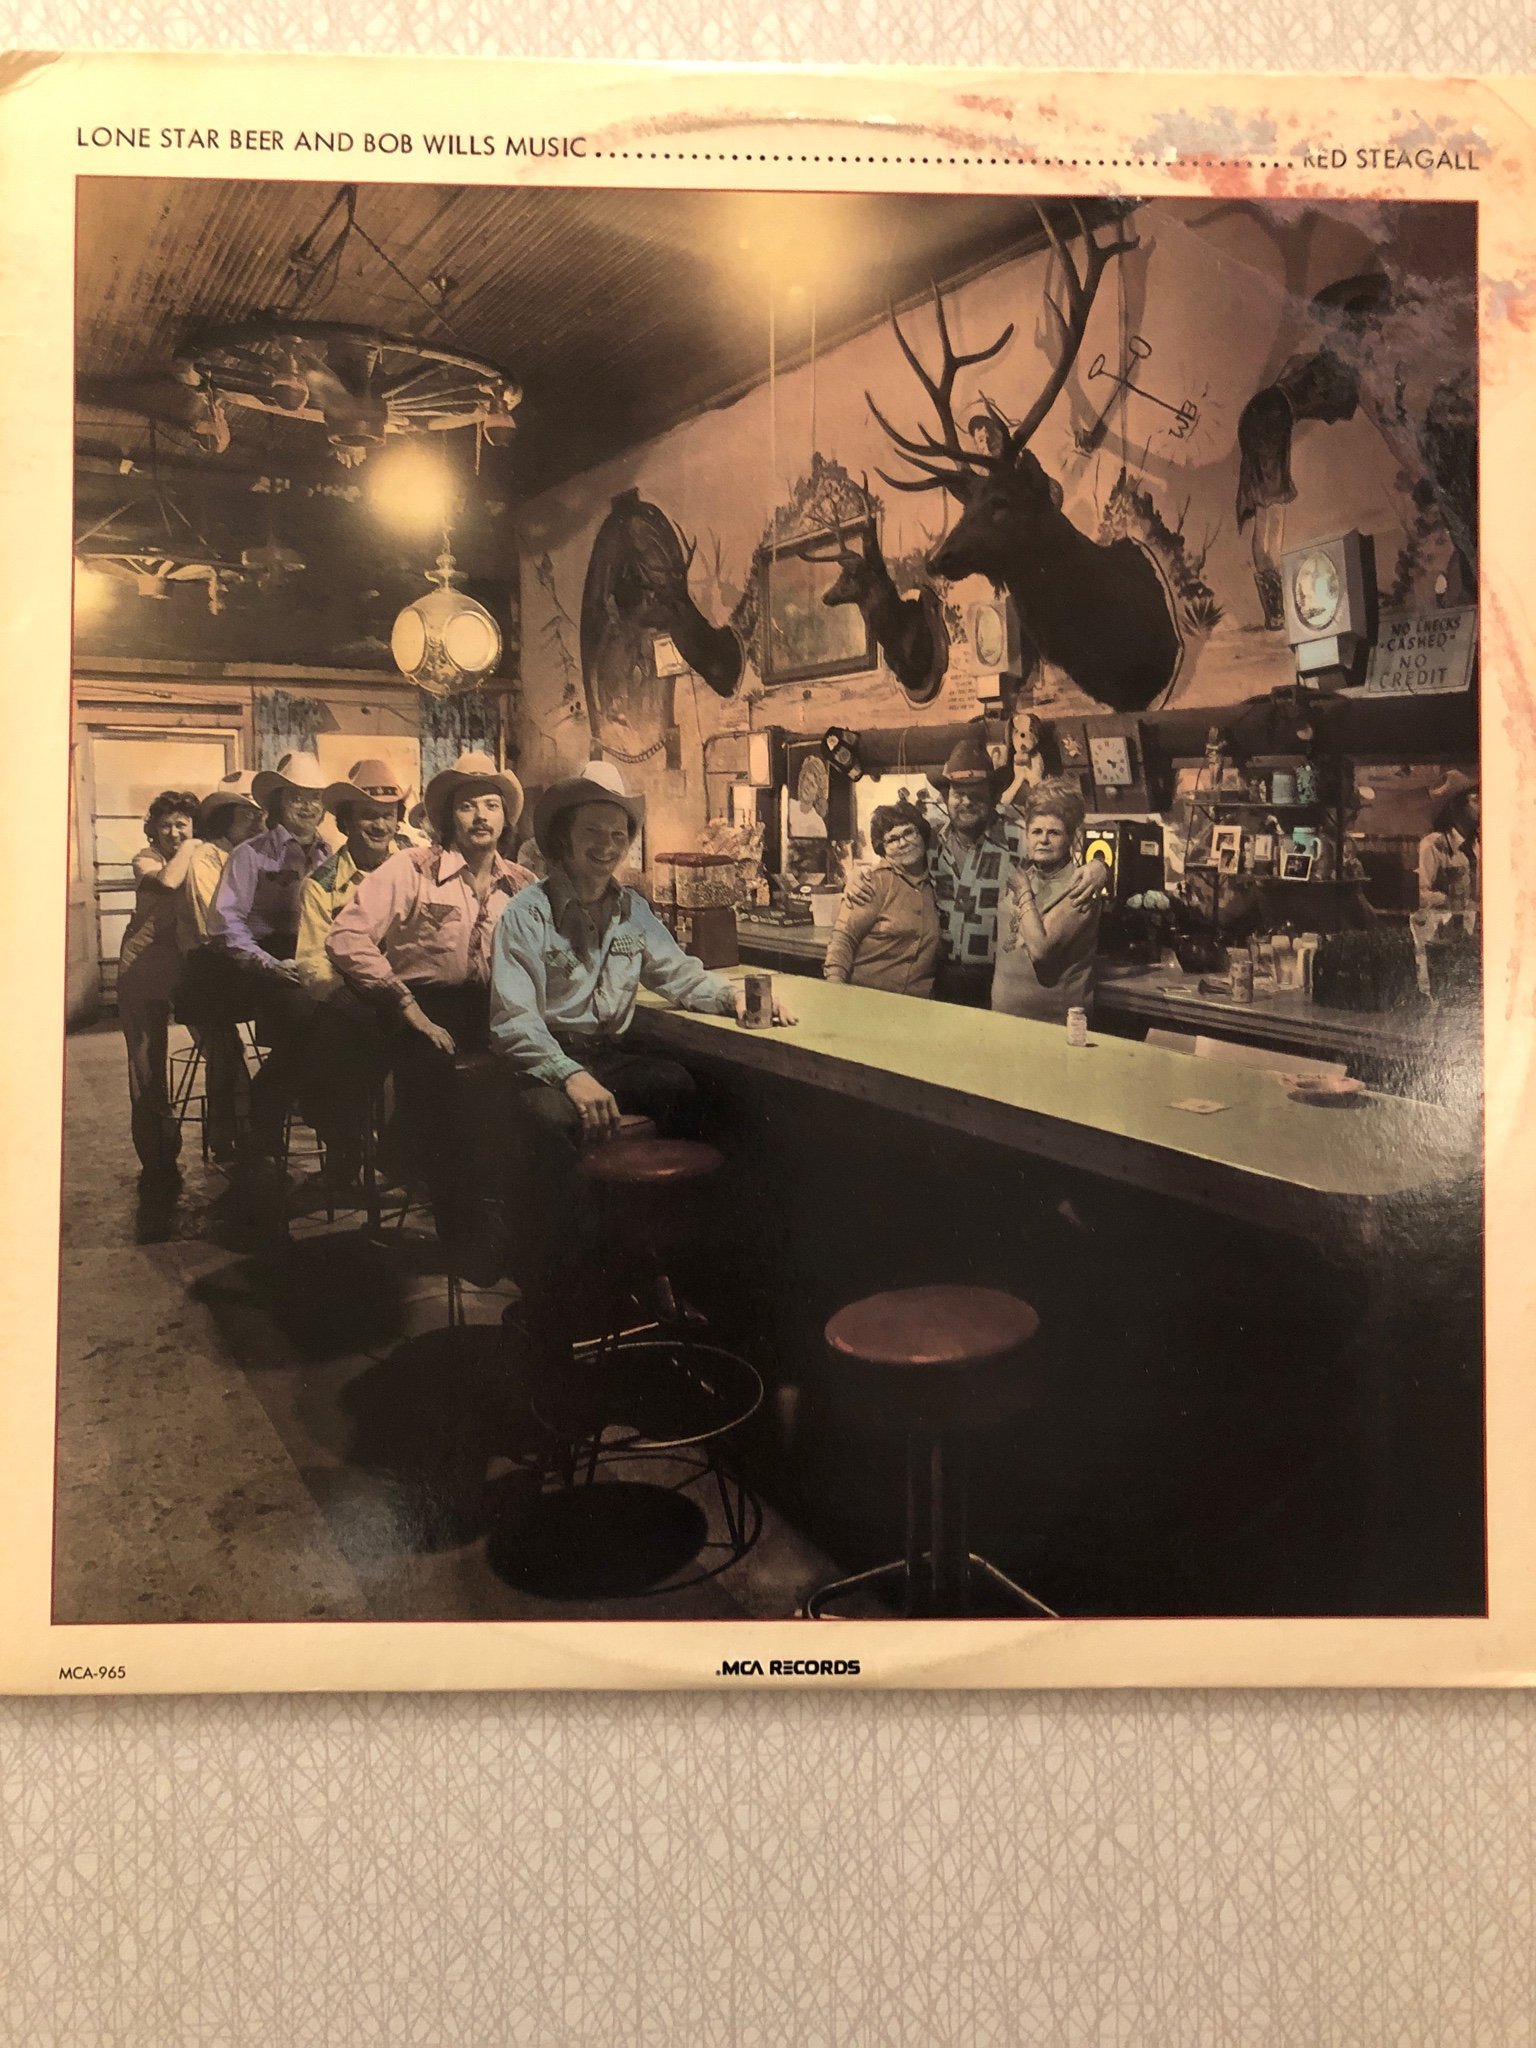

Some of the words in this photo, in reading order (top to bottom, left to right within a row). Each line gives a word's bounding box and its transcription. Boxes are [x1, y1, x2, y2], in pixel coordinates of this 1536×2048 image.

[77, 127, 151, 148] LONE
[160, 128, 219, 149] STAR
[230, 130, 284, 151] BEER
[294, 132, 354, 153] AND
[364, 133, 413, 154] BOB
[423, 134, 496, 156] WILLS
[505, 136, 587, 158] MUSIC
[1303, 149, 1347, 169] RED
[1356, 149, 1480, 170] STEAGALL
[1391, 621, 1411, 636] NO
[1416, 616, 1461, 633] CHECKS
[1400, 654, 1427, 668] NO
[1379, 667, 1447, 690] CREDIT
[58, 1666, 126, 1680] MCA-965
[769, 1659, 861, 1675] RECORDS
